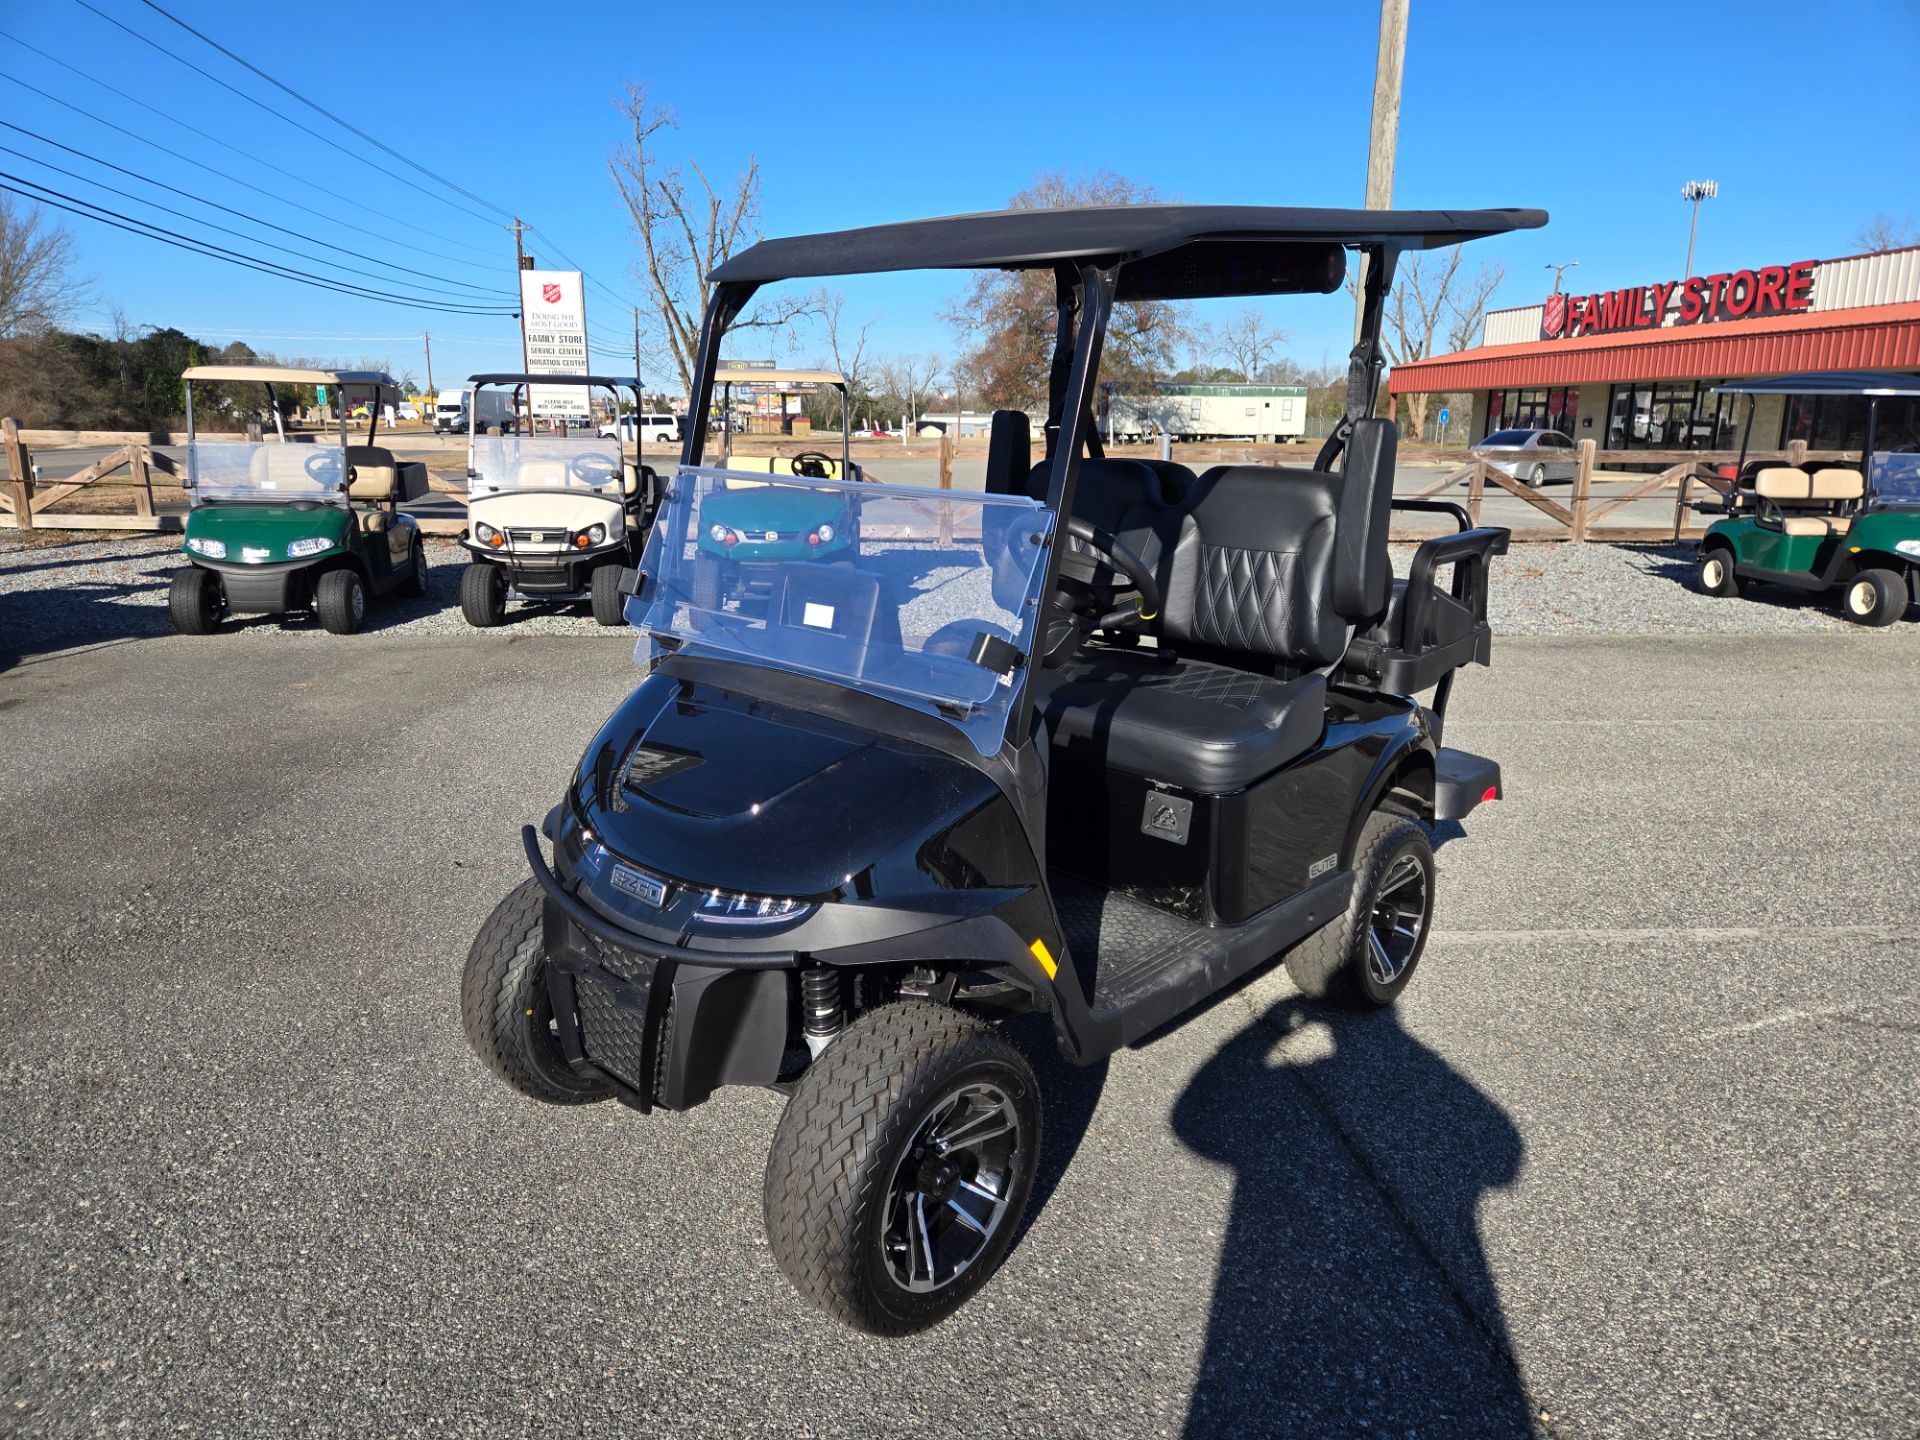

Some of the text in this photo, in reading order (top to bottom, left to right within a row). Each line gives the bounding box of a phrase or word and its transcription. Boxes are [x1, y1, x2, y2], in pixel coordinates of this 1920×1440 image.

[1566, 259, 1819, 333] FAMILY STORE
[528, 334, 584, 344] FAMILY STORE
[530, 347, 583, 356] SERVICE CENTER
[529, 359, 561, 367] DONATION
